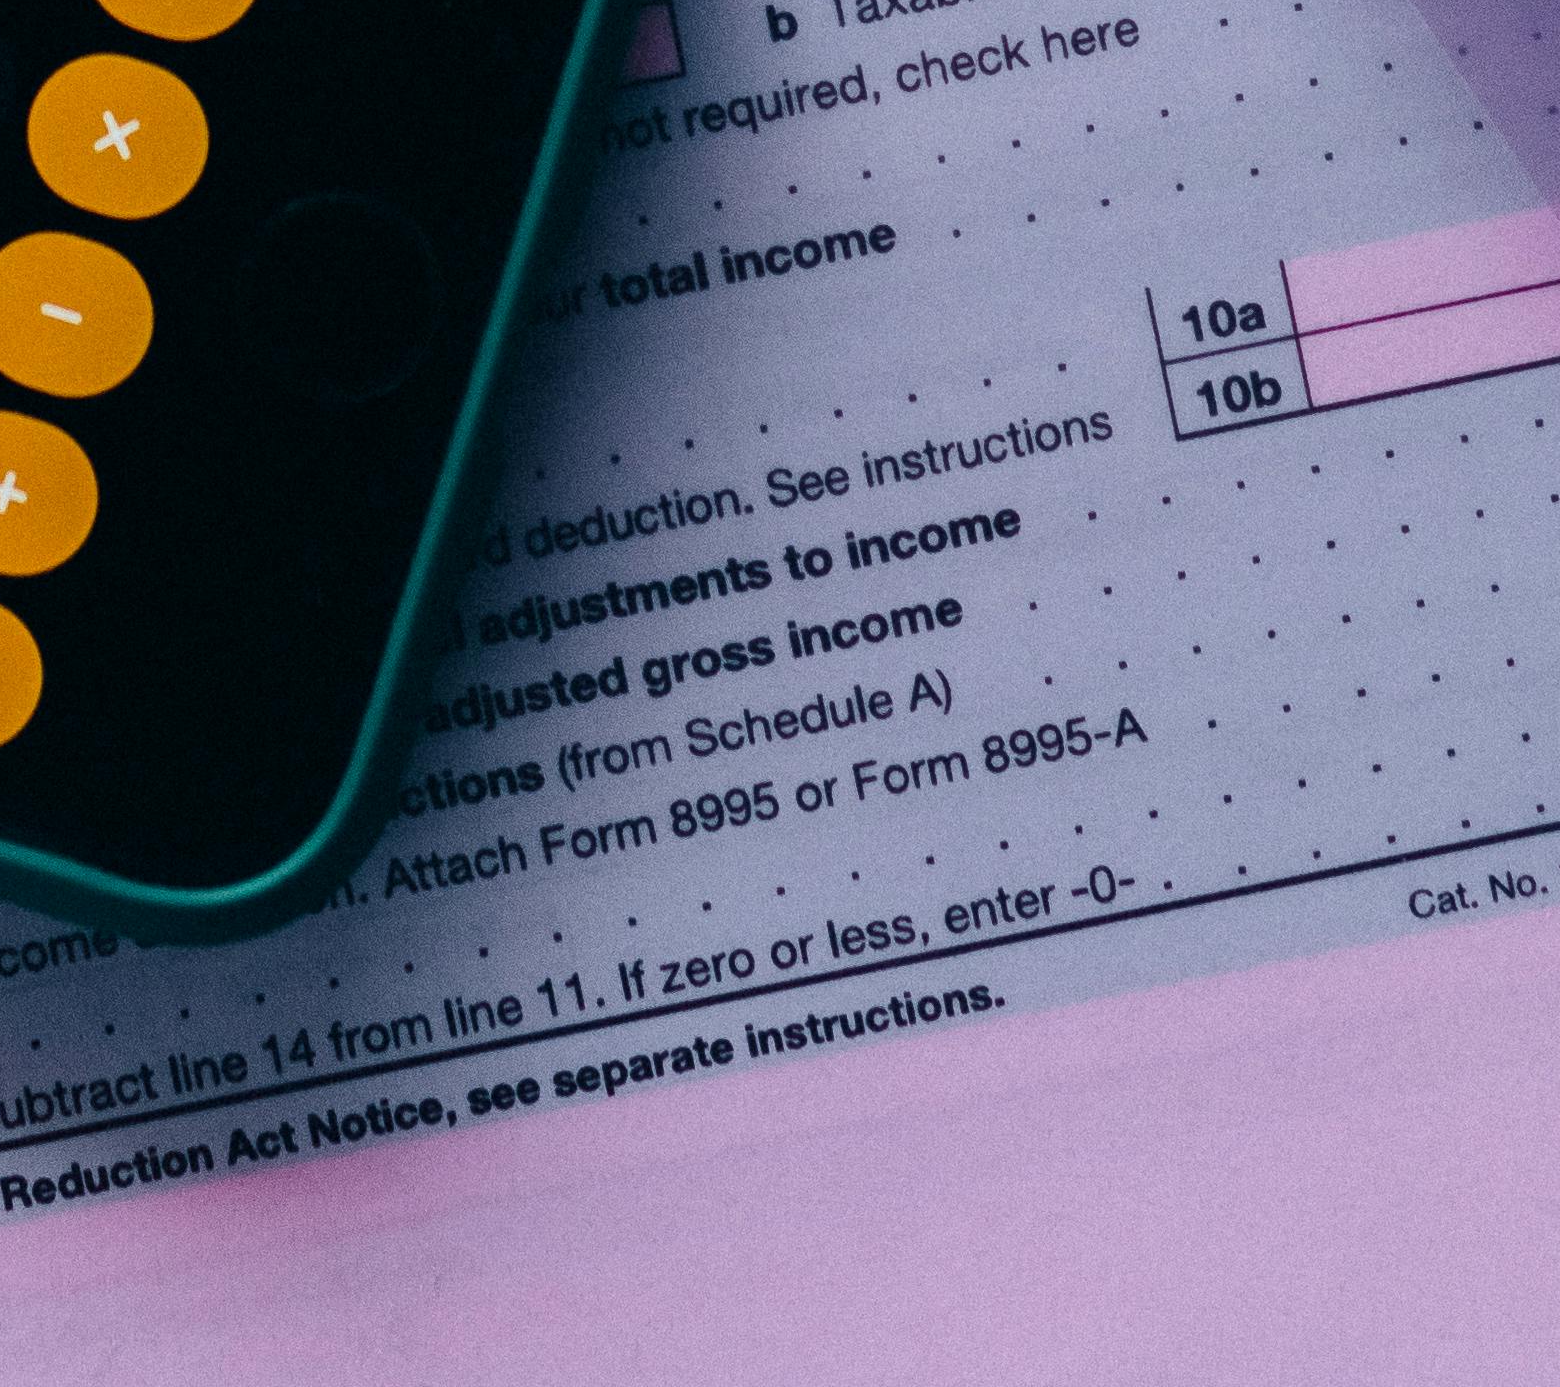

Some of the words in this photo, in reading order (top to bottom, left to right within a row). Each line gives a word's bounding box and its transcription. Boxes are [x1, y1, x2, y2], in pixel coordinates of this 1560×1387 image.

[1181, 299, 1267, 343] 10a
[1196, 370, 1283, 418] 10b
[1407, 882, 1480, 921] Cat.
[1488, 871, 1549, 904] No.
